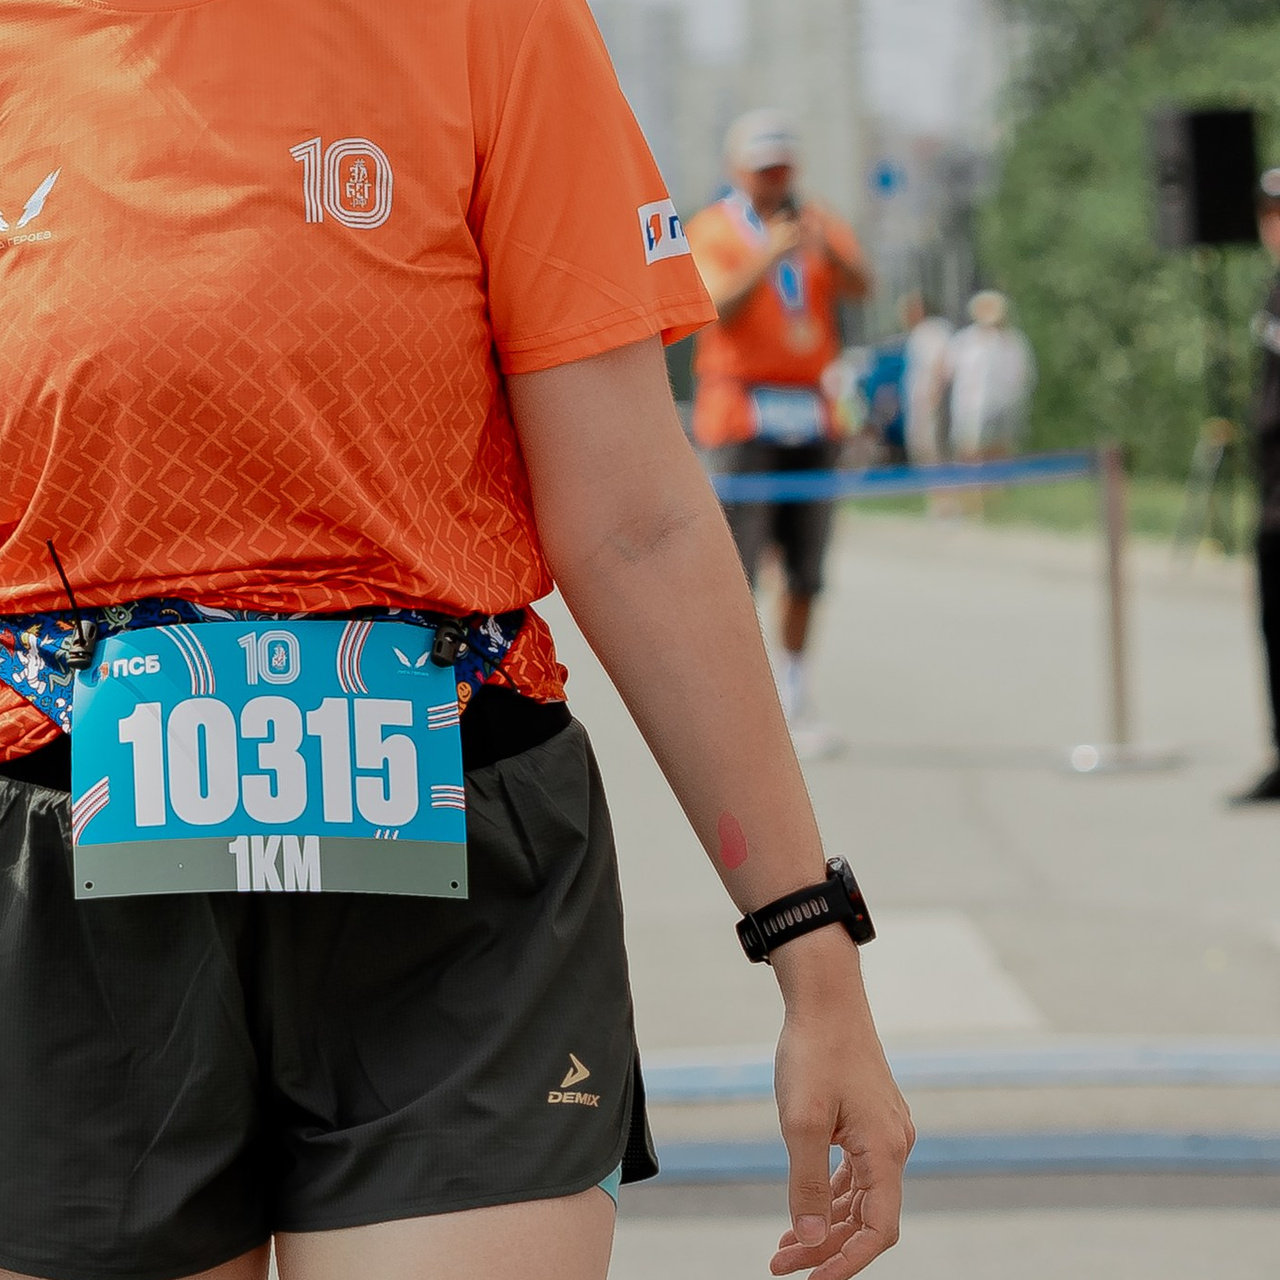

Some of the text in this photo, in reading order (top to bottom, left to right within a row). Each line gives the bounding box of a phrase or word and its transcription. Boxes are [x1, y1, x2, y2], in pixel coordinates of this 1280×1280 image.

[289, 136, 393, 229] 10
[8, 231, 52, 246] ГЕРОЕВ
[113, 654, 160, 678] ПСБ
[237, 630, 300, 685] 10
[119, 696, 418, 826] 10315
[548, 1091, 600, 1107] DEMIX
